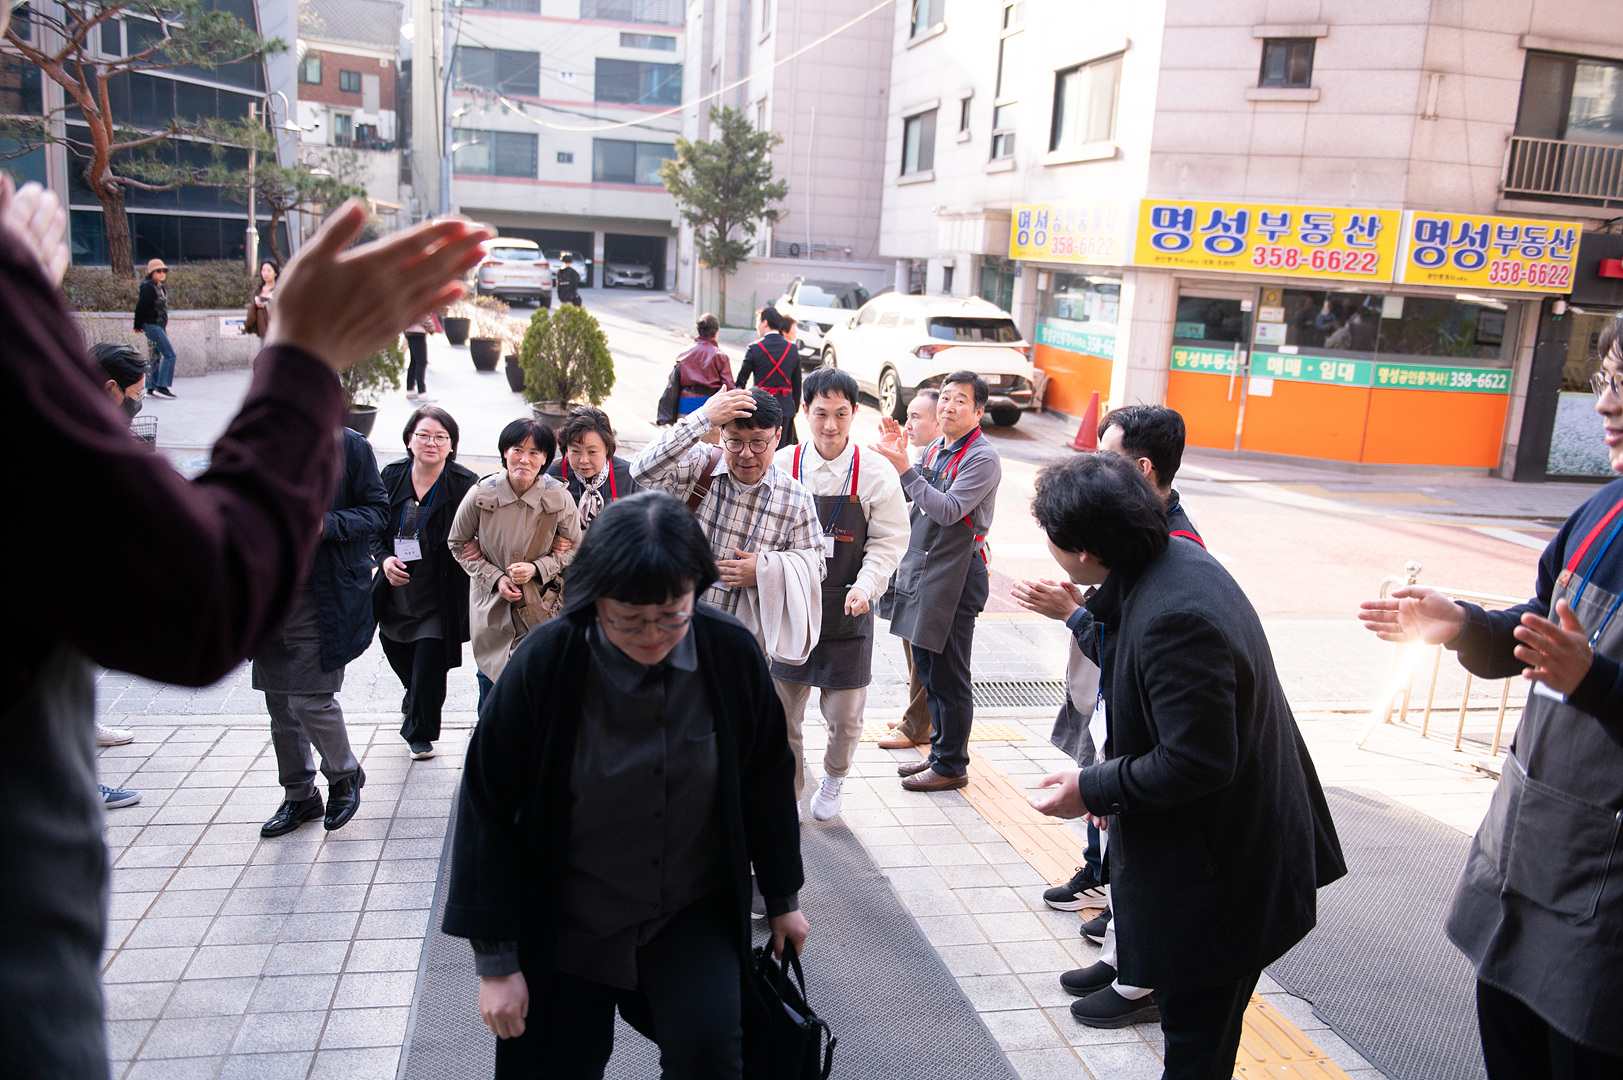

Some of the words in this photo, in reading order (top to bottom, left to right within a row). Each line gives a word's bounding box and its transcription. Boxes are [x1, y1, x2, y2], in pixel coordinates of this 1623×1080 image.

[1017, 209, 1049, 247] 명성
[1151, 206, 1249, 255] 명성
[1256, 211, 1381, 248] 부동산
[1051, 236, 1114, 256] 358-6622
[1413, 219, 1490, 269] 명성
[1493, 225, 1576, 259] 부동산
[1253, 246, 1378, 273] 358-6622
[1489, 261, 1570, 286] 358-6622
[1267, 356, 1301, 377] 매매
[1319, 360, 1355, 382] 임대
[1449, 371, 1507, 389] 358-6622
